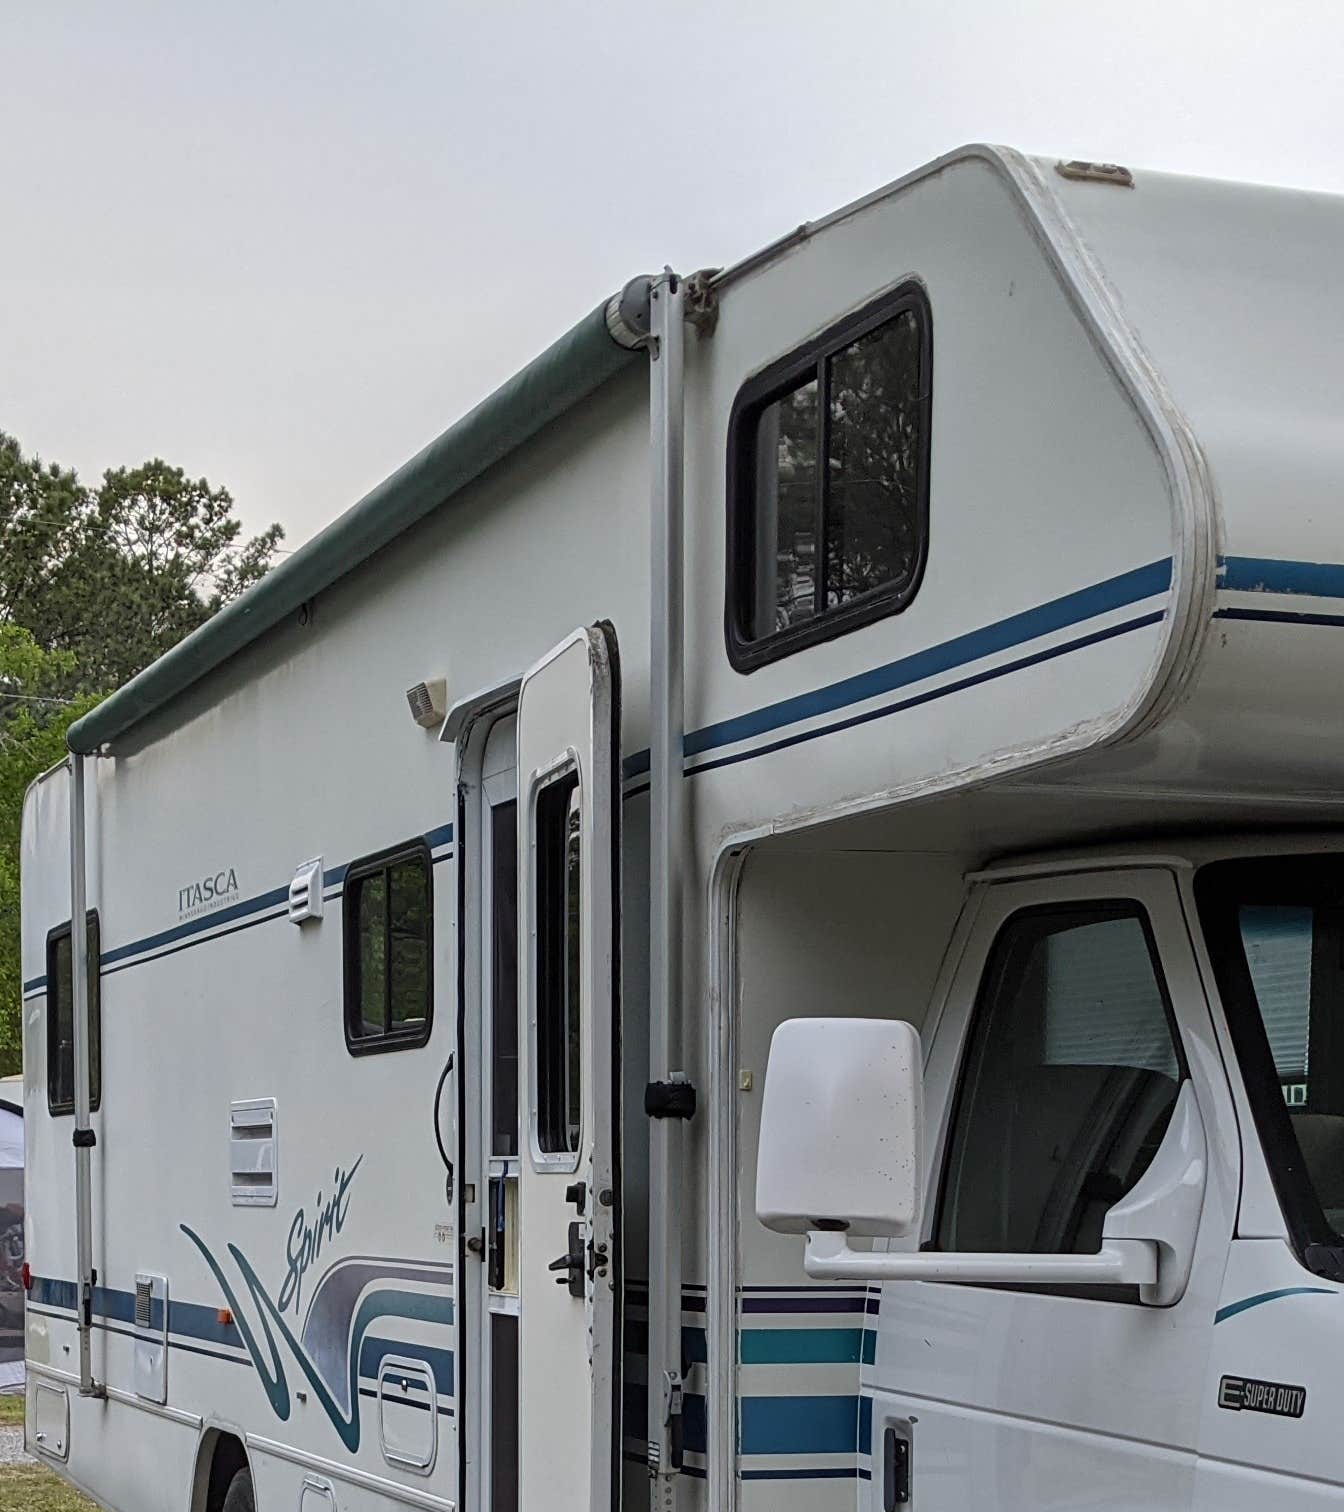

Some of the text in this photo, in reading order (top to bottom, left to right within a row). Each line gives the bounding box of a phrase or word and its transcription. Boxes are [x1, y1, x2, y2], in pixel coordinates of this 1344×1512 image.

[178, 868, 238, 911] ITASCA
[278, 1154, 363, 1315] Spirit
[1276, 1388, 1304, 1415] DUTY
